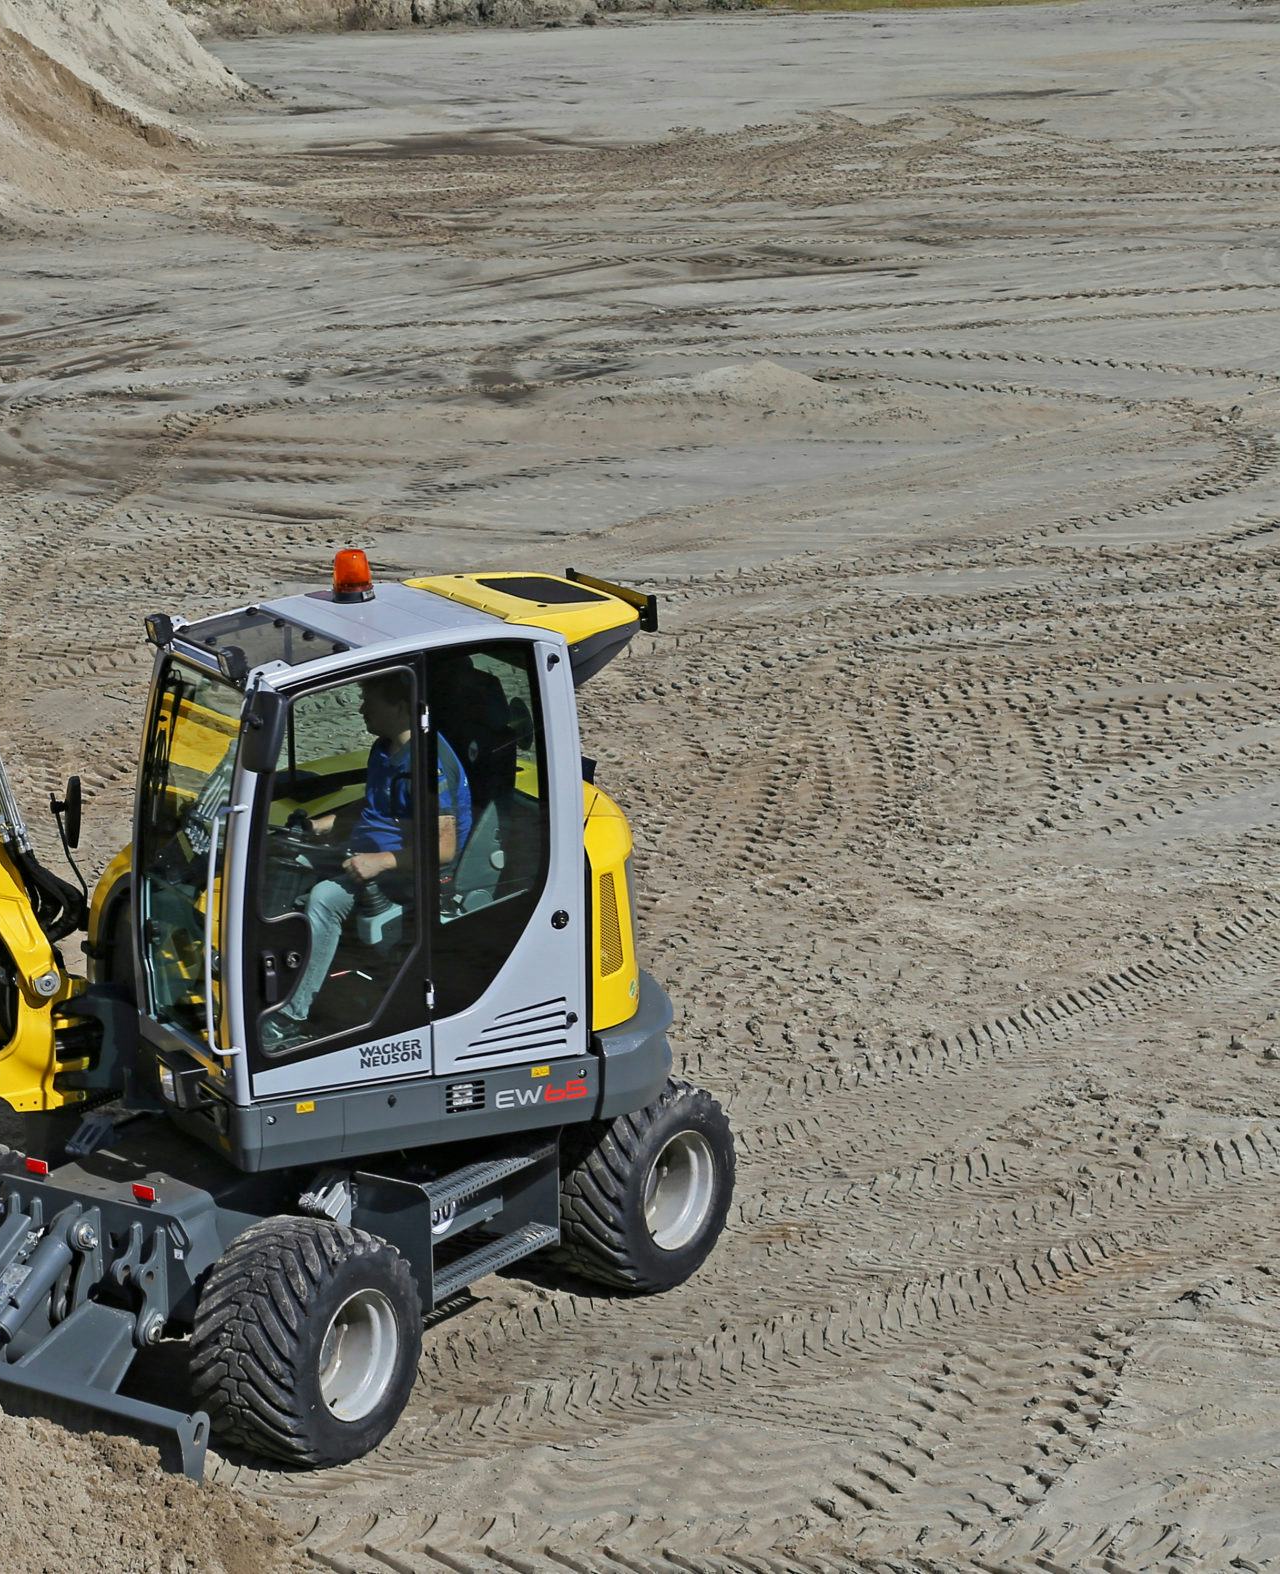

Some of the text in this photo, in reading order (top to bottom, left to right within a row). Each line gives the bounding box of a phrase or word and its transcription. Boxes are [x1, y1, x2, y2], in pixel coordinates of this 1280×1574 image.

[359, 1039, 422, 1058] WACKER
[360, 1050, 422, 1069] NEUSON
[495, 1079, 588, 1109] EW65
